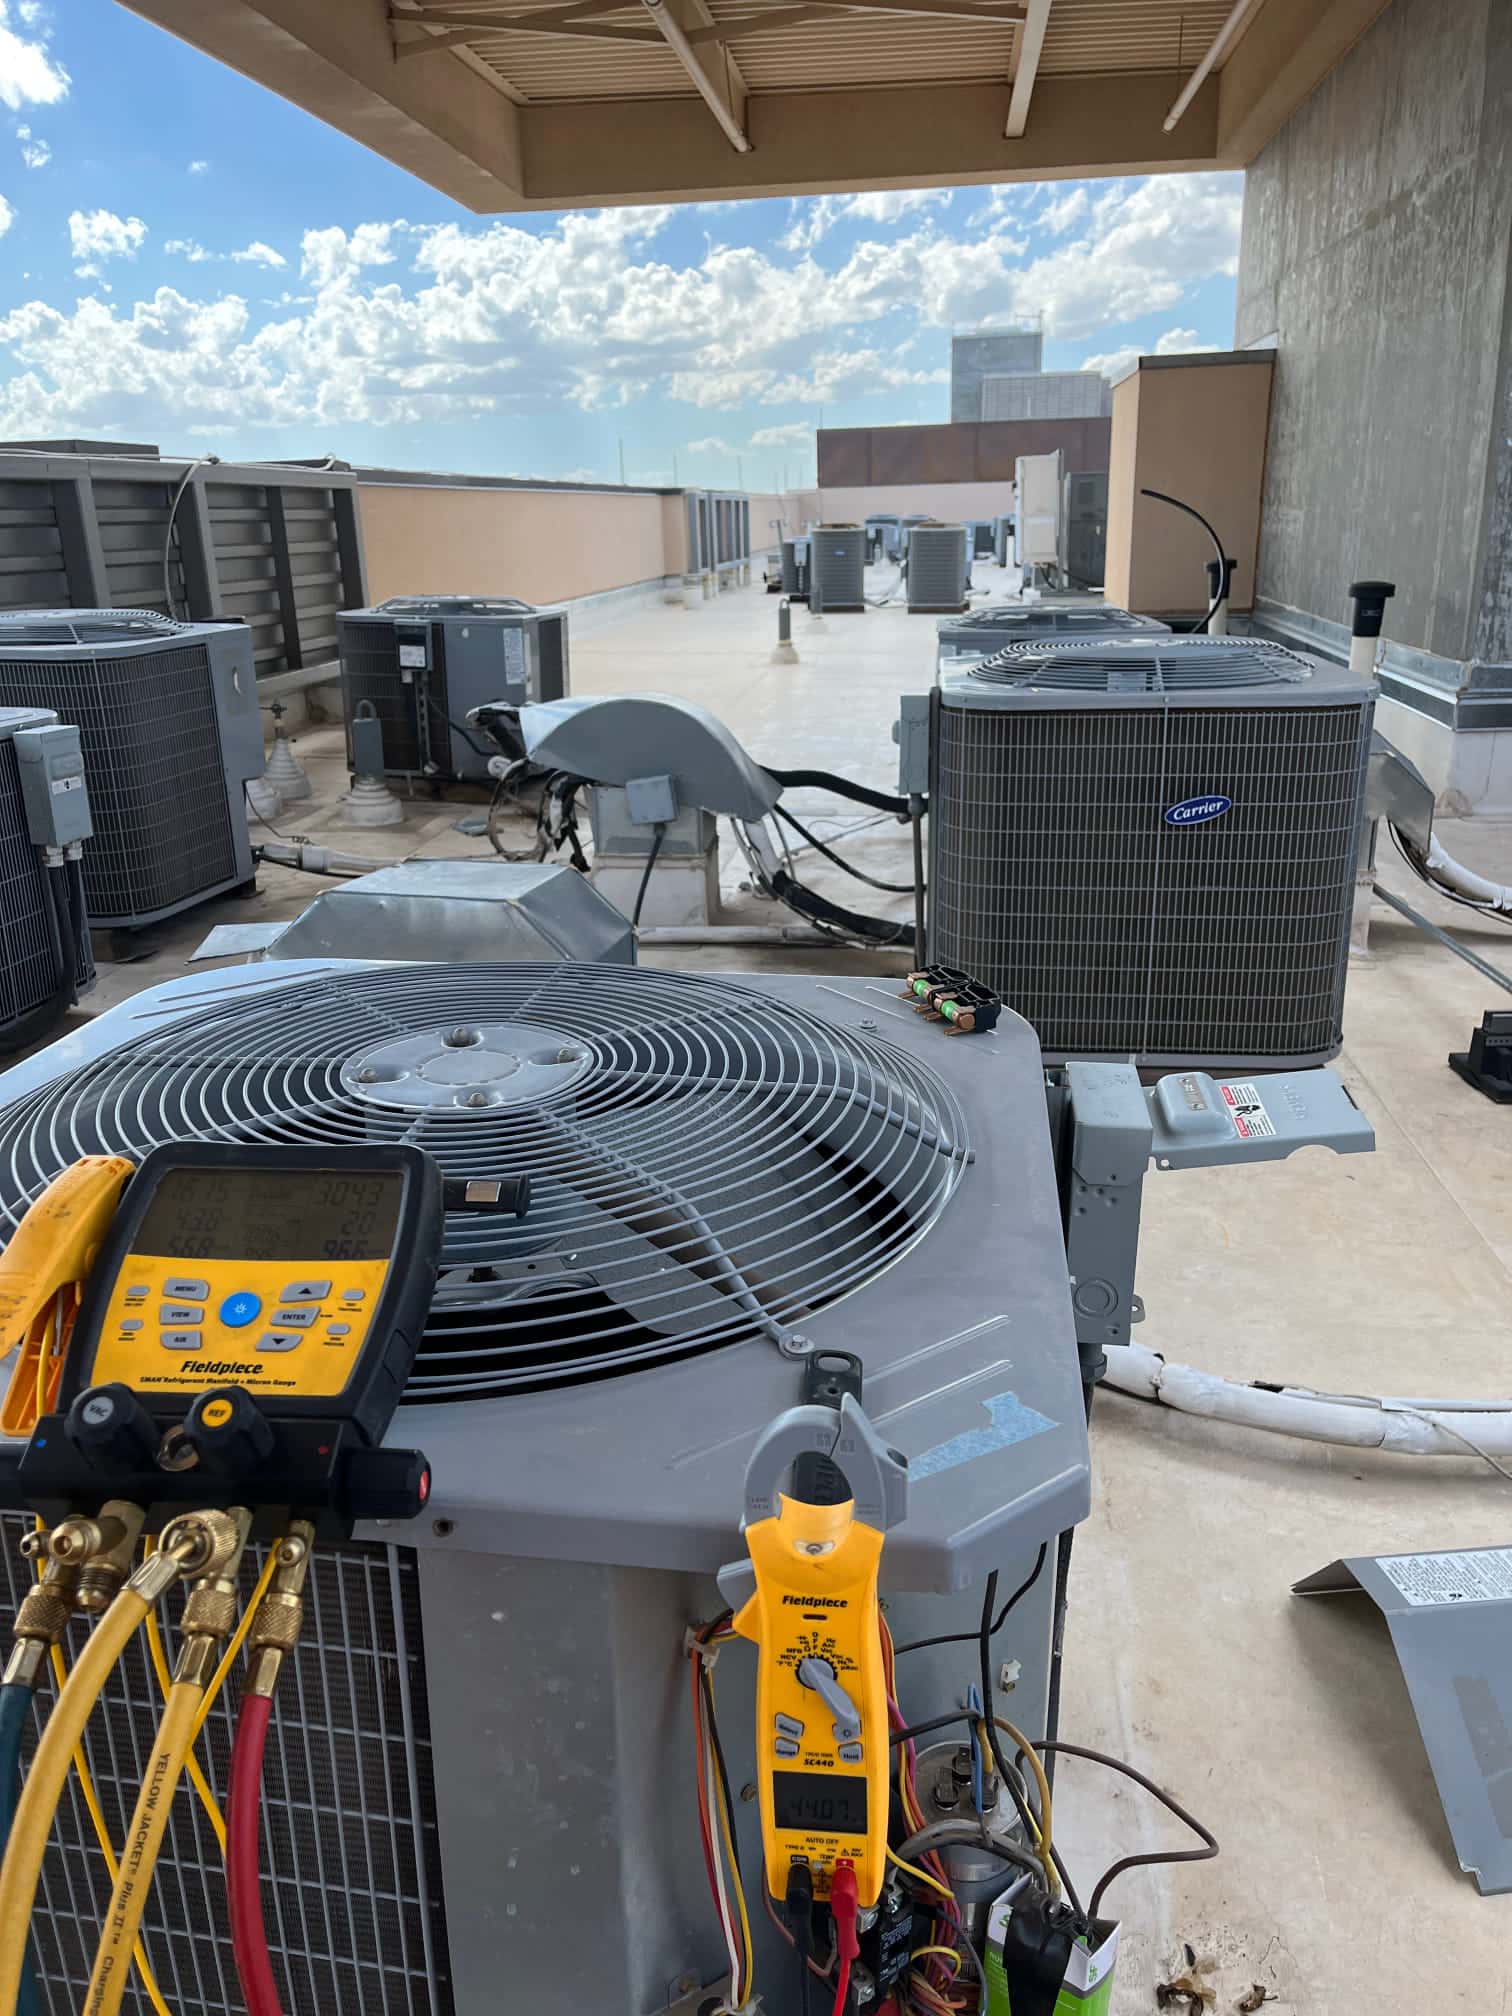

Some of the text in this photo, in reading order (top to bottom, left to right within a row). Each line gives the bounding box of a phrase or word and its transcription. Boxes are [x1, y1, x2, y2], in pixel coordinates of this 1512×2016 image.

[1173, 800, 1224, 820] Carrier
[173, 1285, 197, 1293] MENU
[281, 1313, 306, 1321] ENTER
[181, 1361, 263, 1375] Fieldpiece
[163, 1376, 204, 1385] Refrigerant
[89, 1404, 107, 1417] VAC
[782, 1595, 848, 1608] Fieldpiece
[804, 1758, 835, 1767] SC440
[146, 1752, 170, 1810] YELLOW
[117, 1880, 134, 1910] Plus
